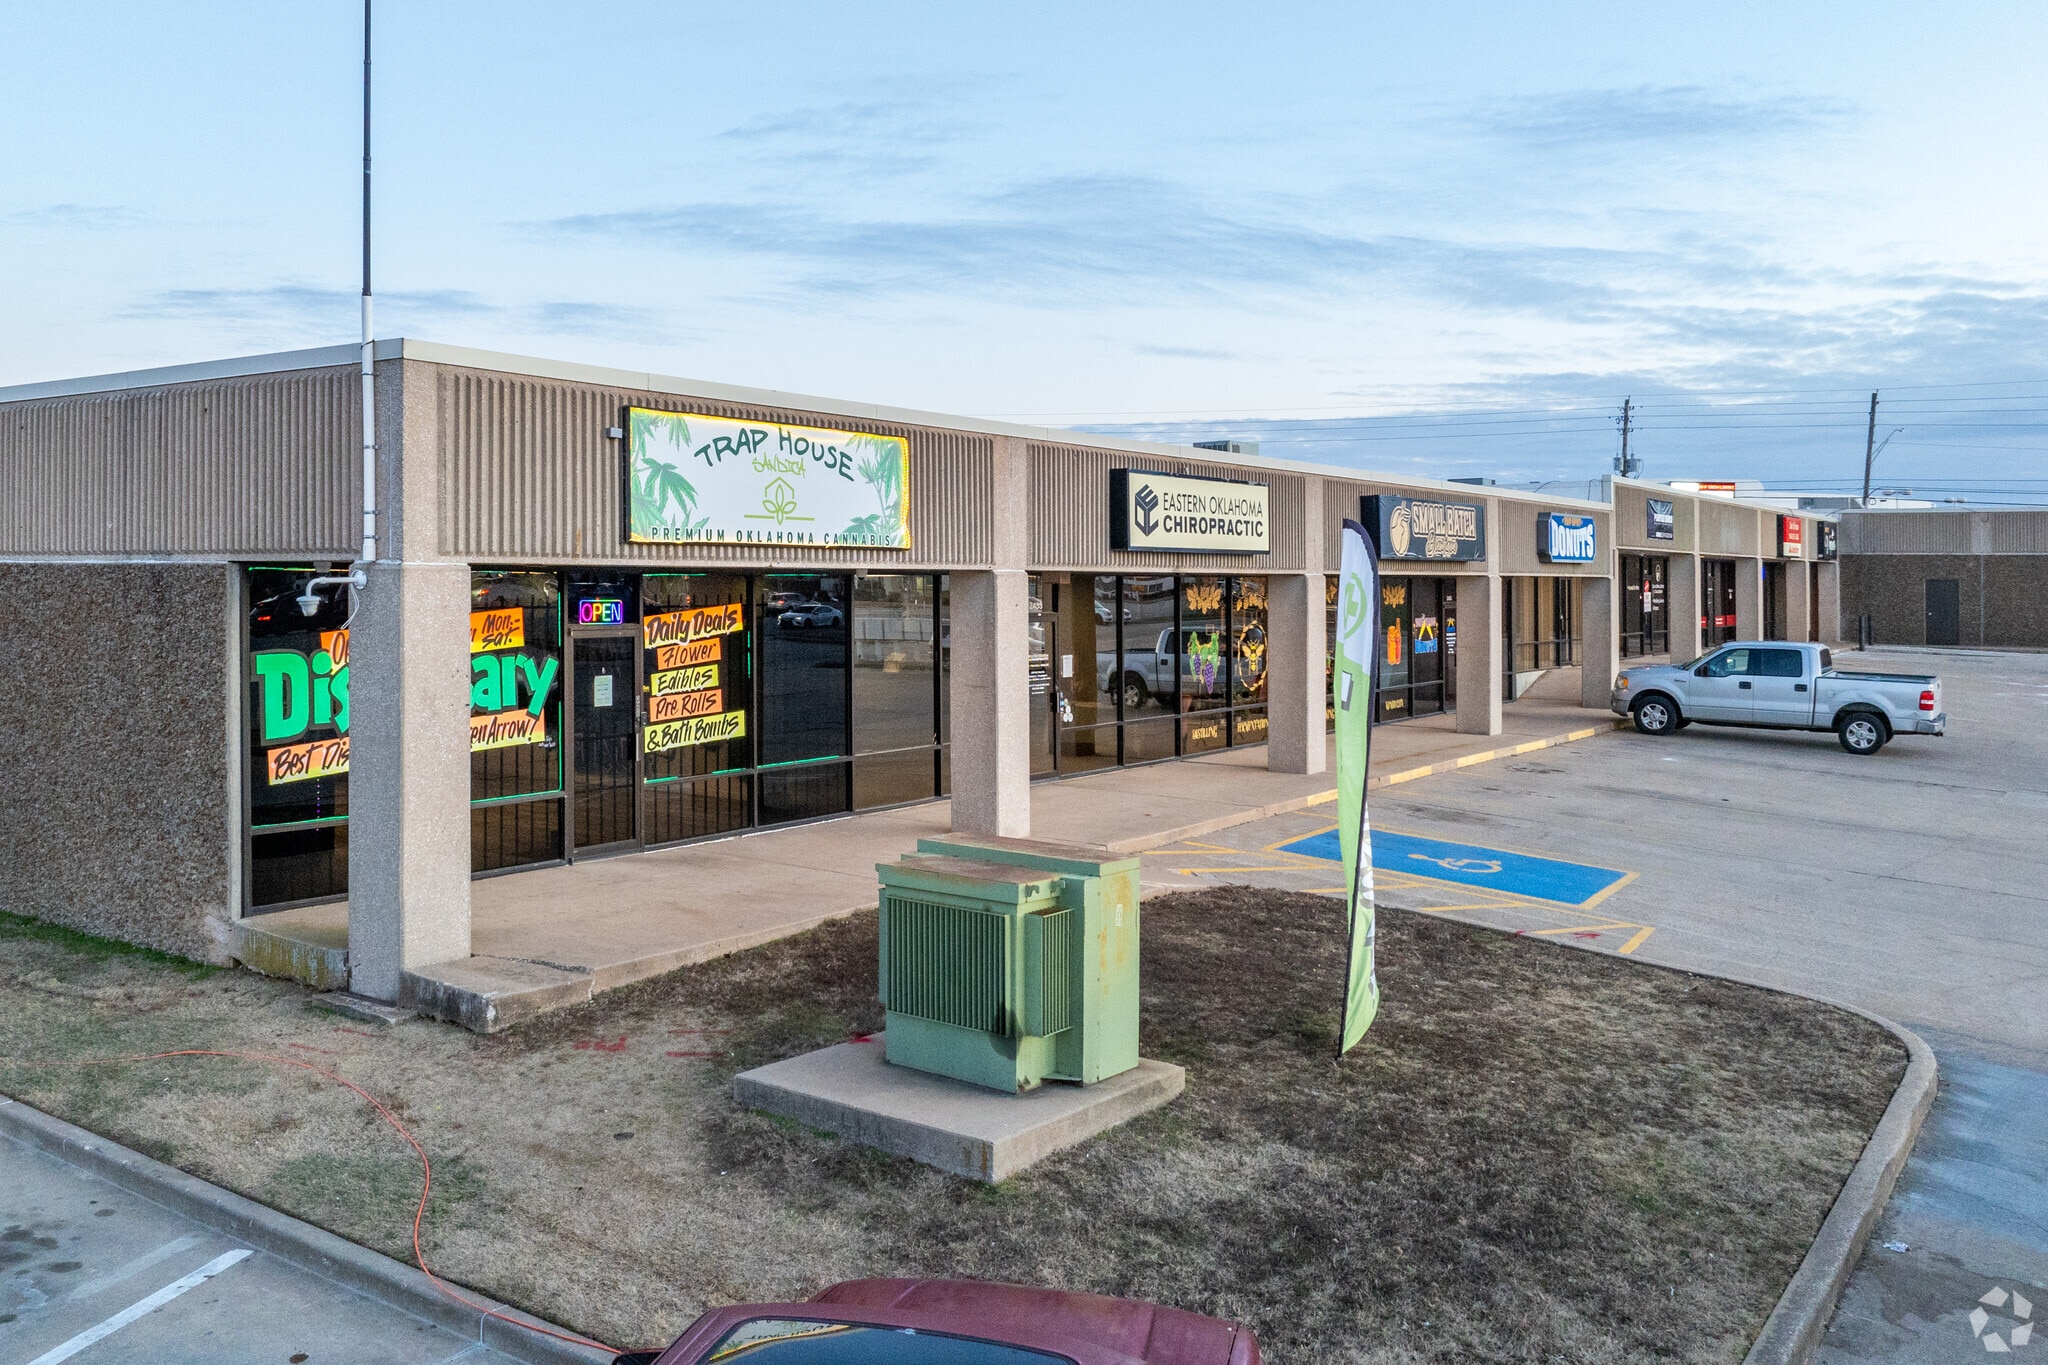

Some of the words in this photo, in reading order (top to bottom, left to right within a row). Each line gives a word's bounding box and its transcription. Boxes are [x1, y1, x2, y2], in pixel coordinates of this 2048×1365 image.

[694, 427, 769, 467] TRAP
[779, 427, 855, 482] HOUSE
[1163, 492, 1206, 513] EASTERN
[1209, 496, 1263, 518] OKLAHOMA
[1412, 501, 1445, 539] SMALL
[1446, 503, 1477, 540] BATCH
[652, 527, 725, 541] PREMIUM
[736, 530, 814, 545] OKLAHOMA
[824, 532, 891, 546] CANNABIS
[1163, 514, 1263, 538] CHIROPRACTIC
[1552, 519, 1594, 558] DONUTS
[581, 603, 621, 622] OPEN
[646, 613, 690, 644] Daily
[693, 605, 738, 634] Deals
[662, 643, 717, 668] Flower
[470, 653, 559, 717] ary
[657, 668, 713, 693] Edibles
[656, 698, 679, 719] Pre
[680, 693, 717, 715] Rolls
[647, 730, 660, 751] &
[661, 720, 692, 747] Bath
[694, 714, 739, 741] Bombs
[273, 744, 323, 780] Best
